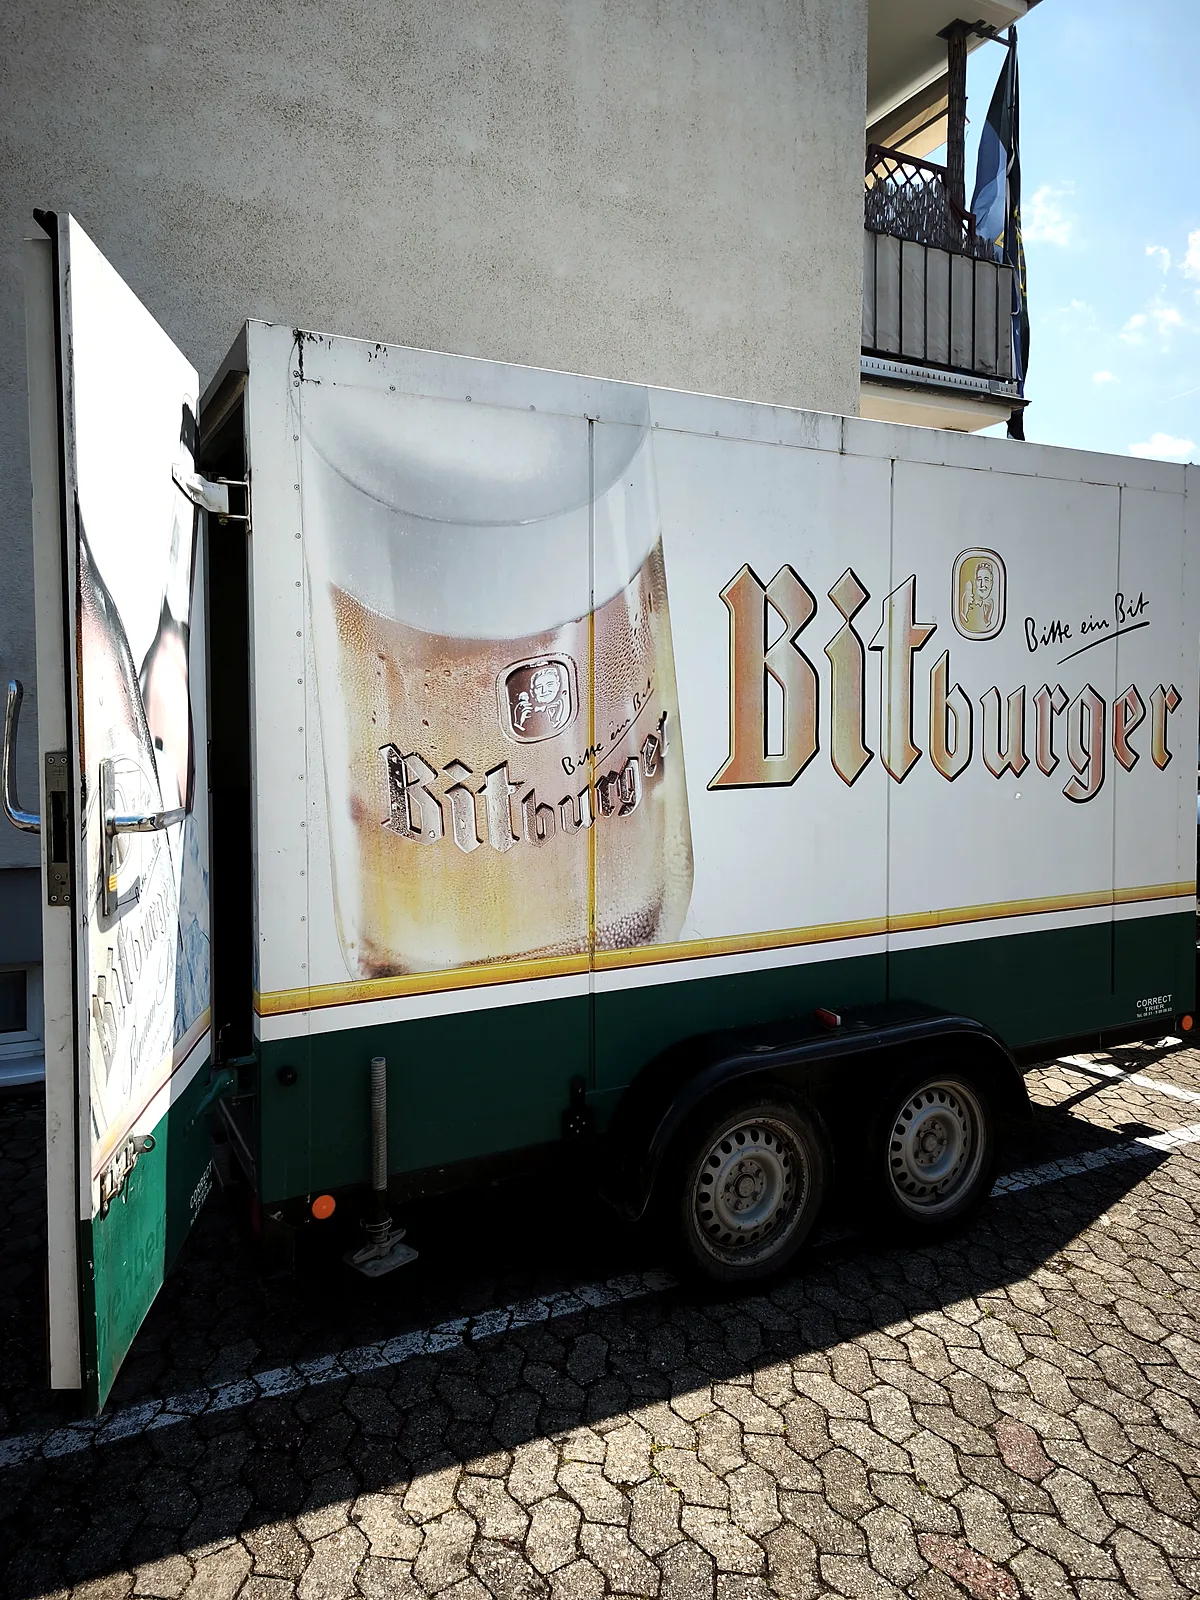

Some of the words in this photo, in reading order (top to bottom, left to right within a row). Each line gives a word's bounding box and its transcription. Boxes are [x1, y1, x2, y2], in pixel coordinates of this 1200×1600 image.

[1024, 616, 1072, 653] Bitte
[1080, 614, 1110, 635] ein
[1115, 591, 1150, 624] Bit
[706, 563, 1183, 804] Bitburger
[610, 720, 631, 741] ein
[378, 709, 670, 855] Bitburger
[1136, 993, 1173, 1008] CORRECT
[1144, 1003, 1165, 1012] TRIER
